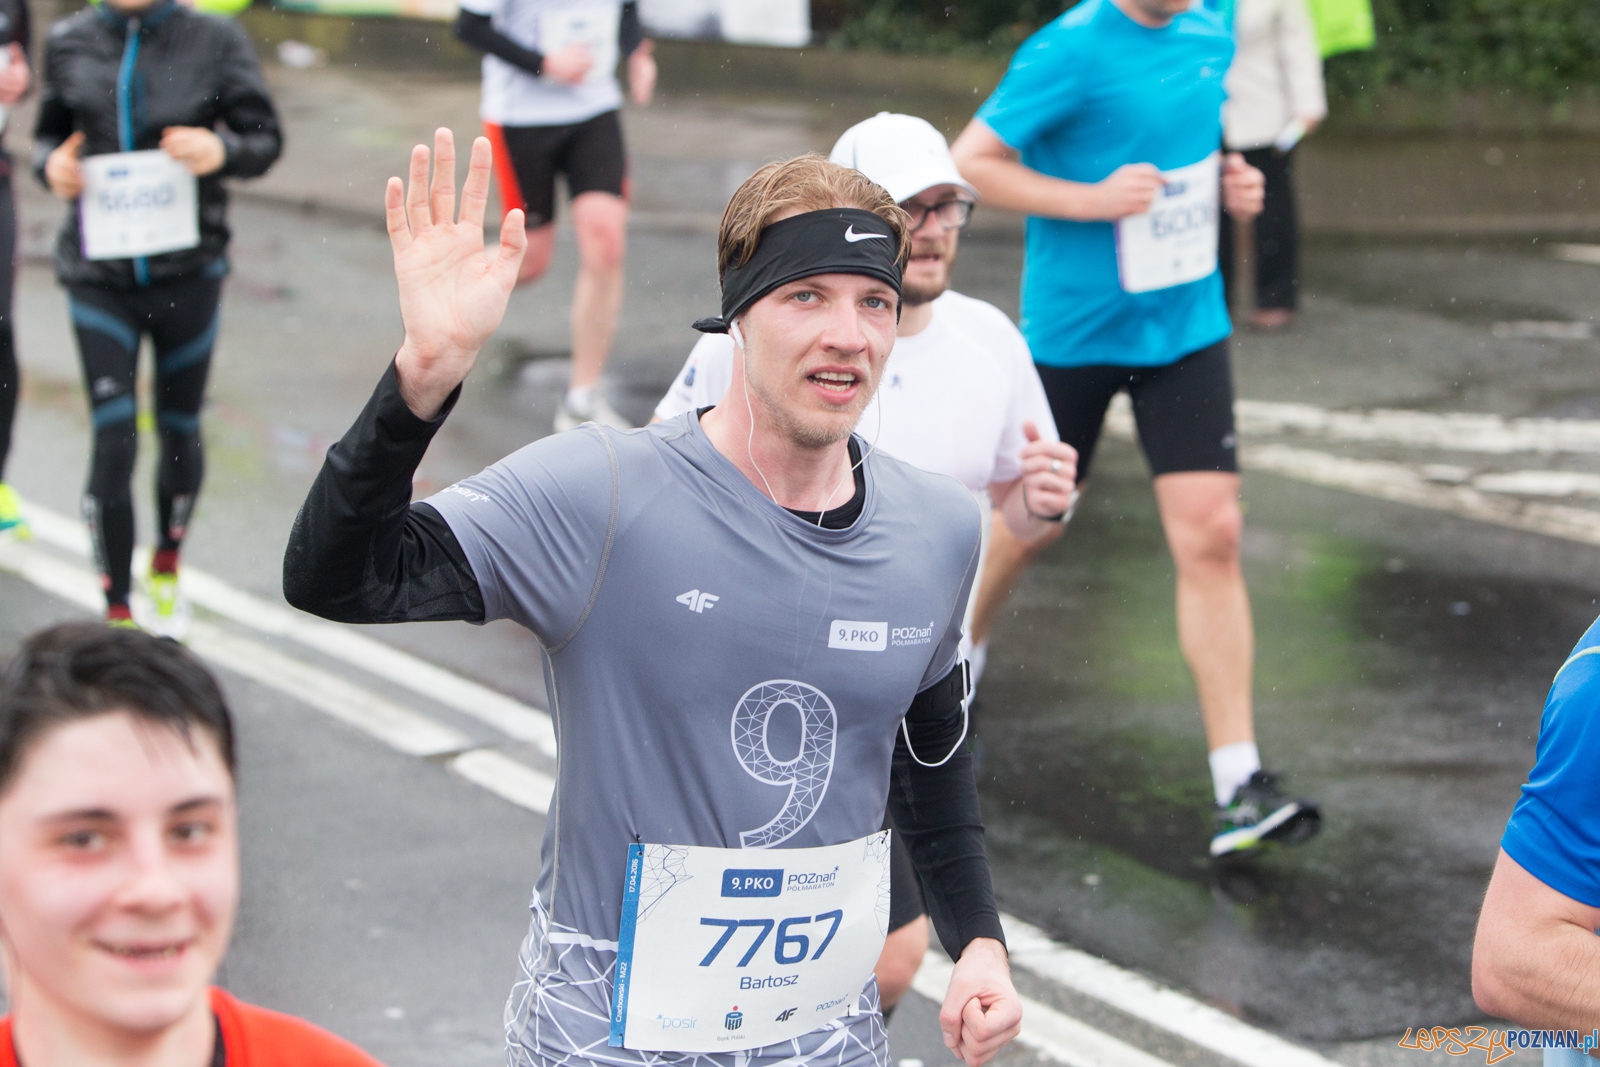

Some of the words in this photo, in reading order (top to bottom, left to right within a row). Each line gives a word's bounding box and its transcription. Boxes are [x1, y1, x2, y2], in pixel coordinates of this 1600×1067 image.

[675, 589, 720, 613] 4F
[838, 628, 848, 641] 9.
[851, 629, 879, 643] PKO
[730, 679, 838, 849] 9
[628, 858, 639, 893] 17.04.2016
[731, 876, 742, 890] 9.
[744, 876, 774, 890] PKO
[786, 881, 835, 892] PÓŁMARATON
[698, 909, 843, 967] 7767
[619, 961, 628, 979] M22
[739, 974, 799, 990] Bartosz
[716, 1034, 730, 1042] Bank
[730, 1033, 746, 1041] Polski
